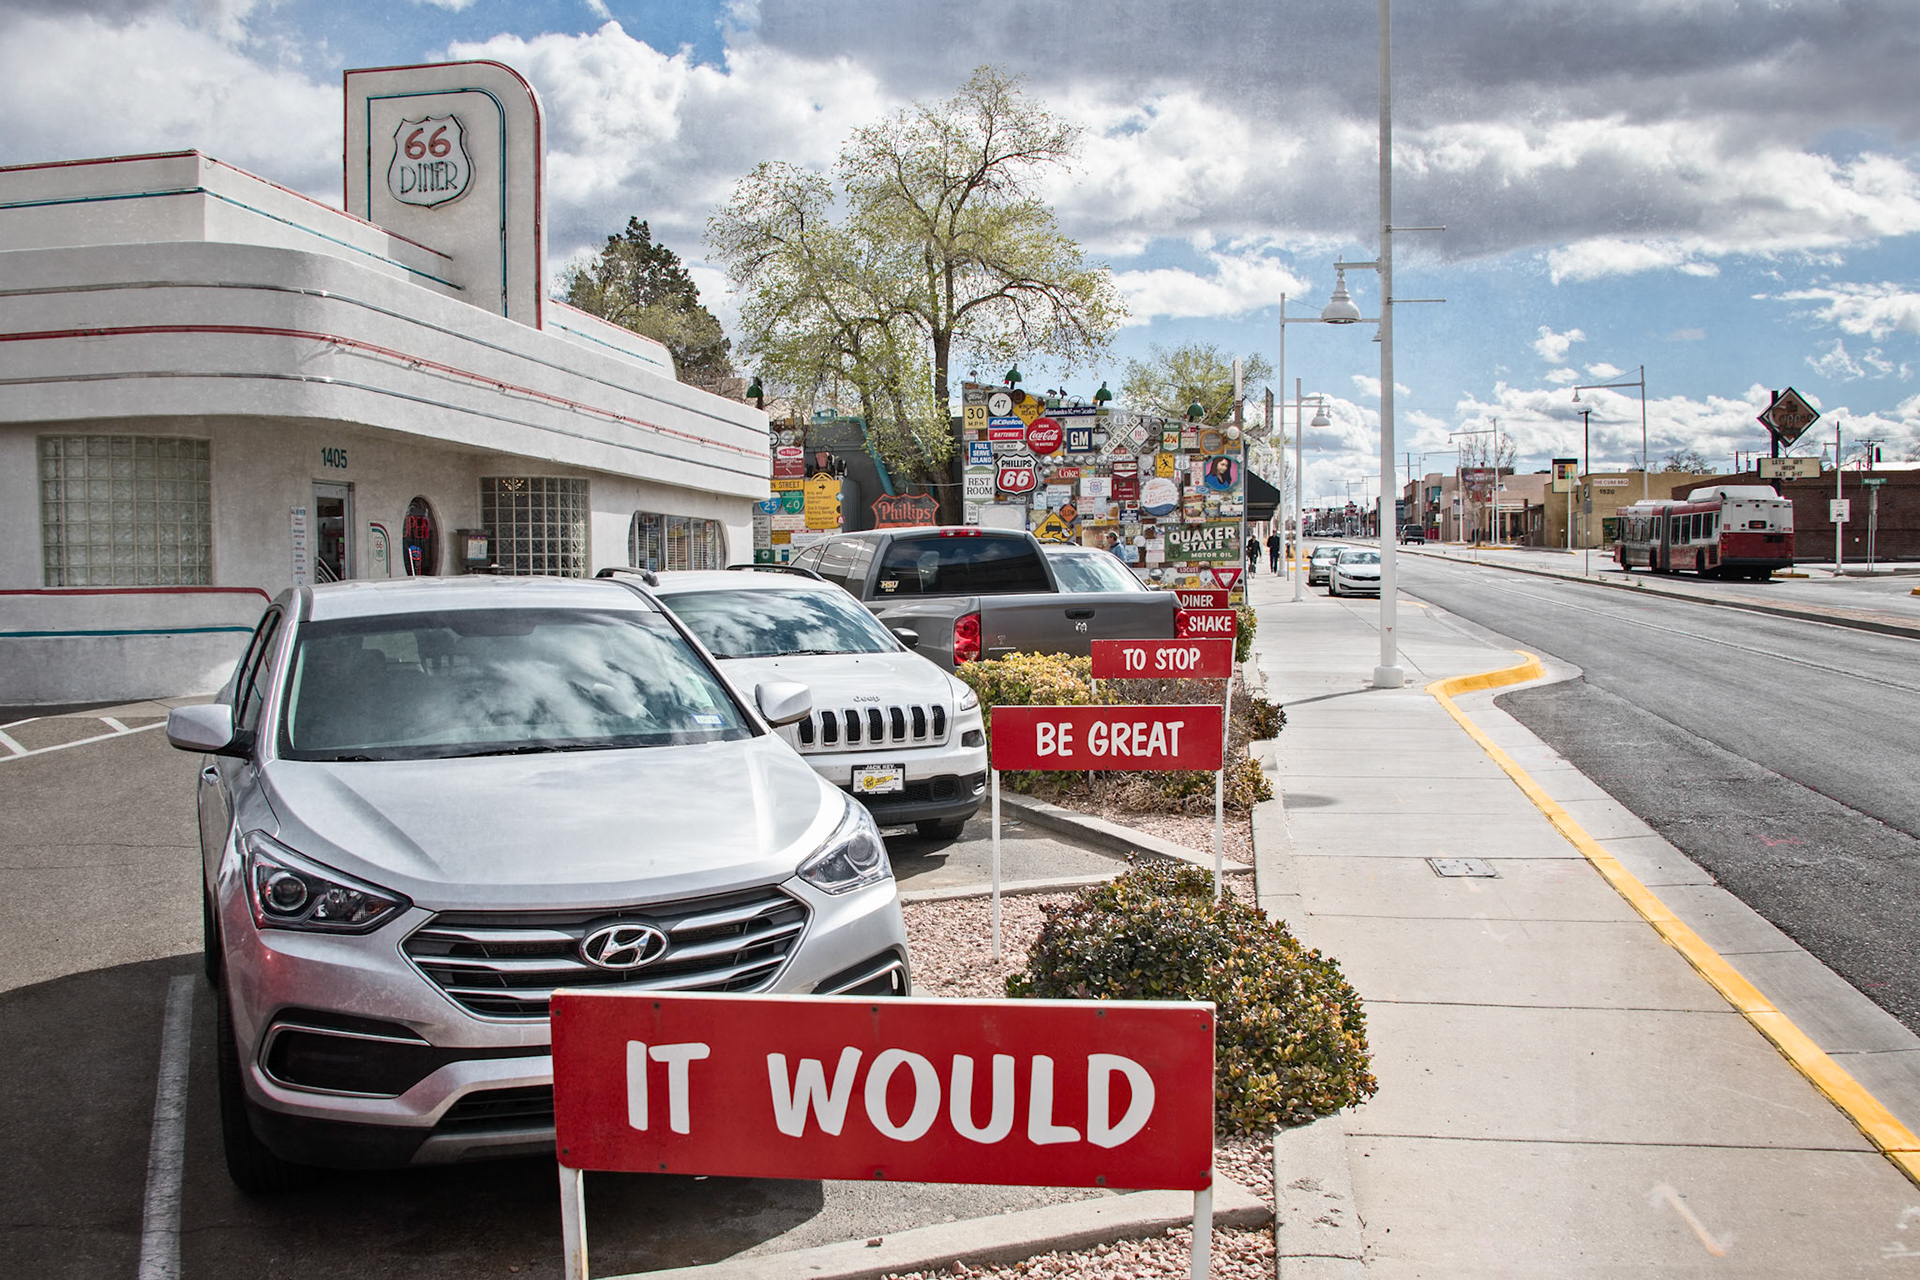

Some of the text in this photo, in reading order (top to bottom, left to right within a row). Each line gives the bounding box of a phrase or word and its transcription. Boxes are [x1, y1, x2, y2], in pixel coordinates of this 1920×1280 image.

[405, 126, 451, 160] 66
[400, 161, 458, 194] DINER
[994, 400, 1006, 409] 47
[967, 408, 984, 420] 30
[1028, 430, 1058, 442] Coca-Cola
[1070, 432, 1088, 446] GM
[1102, 418, 1138, 454] RAIL ROAD
[1104, 418, 1137, 452] CROSSING
[321, 446, 348, 469] 1405
[1002, 460, 1032, 468] PHILLIPS
[1002, 470, 1029, 487] 66
[1058, 468, 1079, 478] Coke
[764, 502, 777, 511] 25
[786, 500, 800, 510] 40
[879, 502, 931, 525] Phillips
[1169, 526, 1236, 544] QUAKER
[376, 540, 383, 549] 66
[1182, 540, 1222, 552] STATE
[1182, 594, 1214, 607] DINER
[1188, 615, 1232, 632] SHAKE
[1123, 647, 1200, 671] TO STOP
[1036, 721, 1184, 757] BE GREAT
[626, 1040, 1155, 1150] IT WOULD
